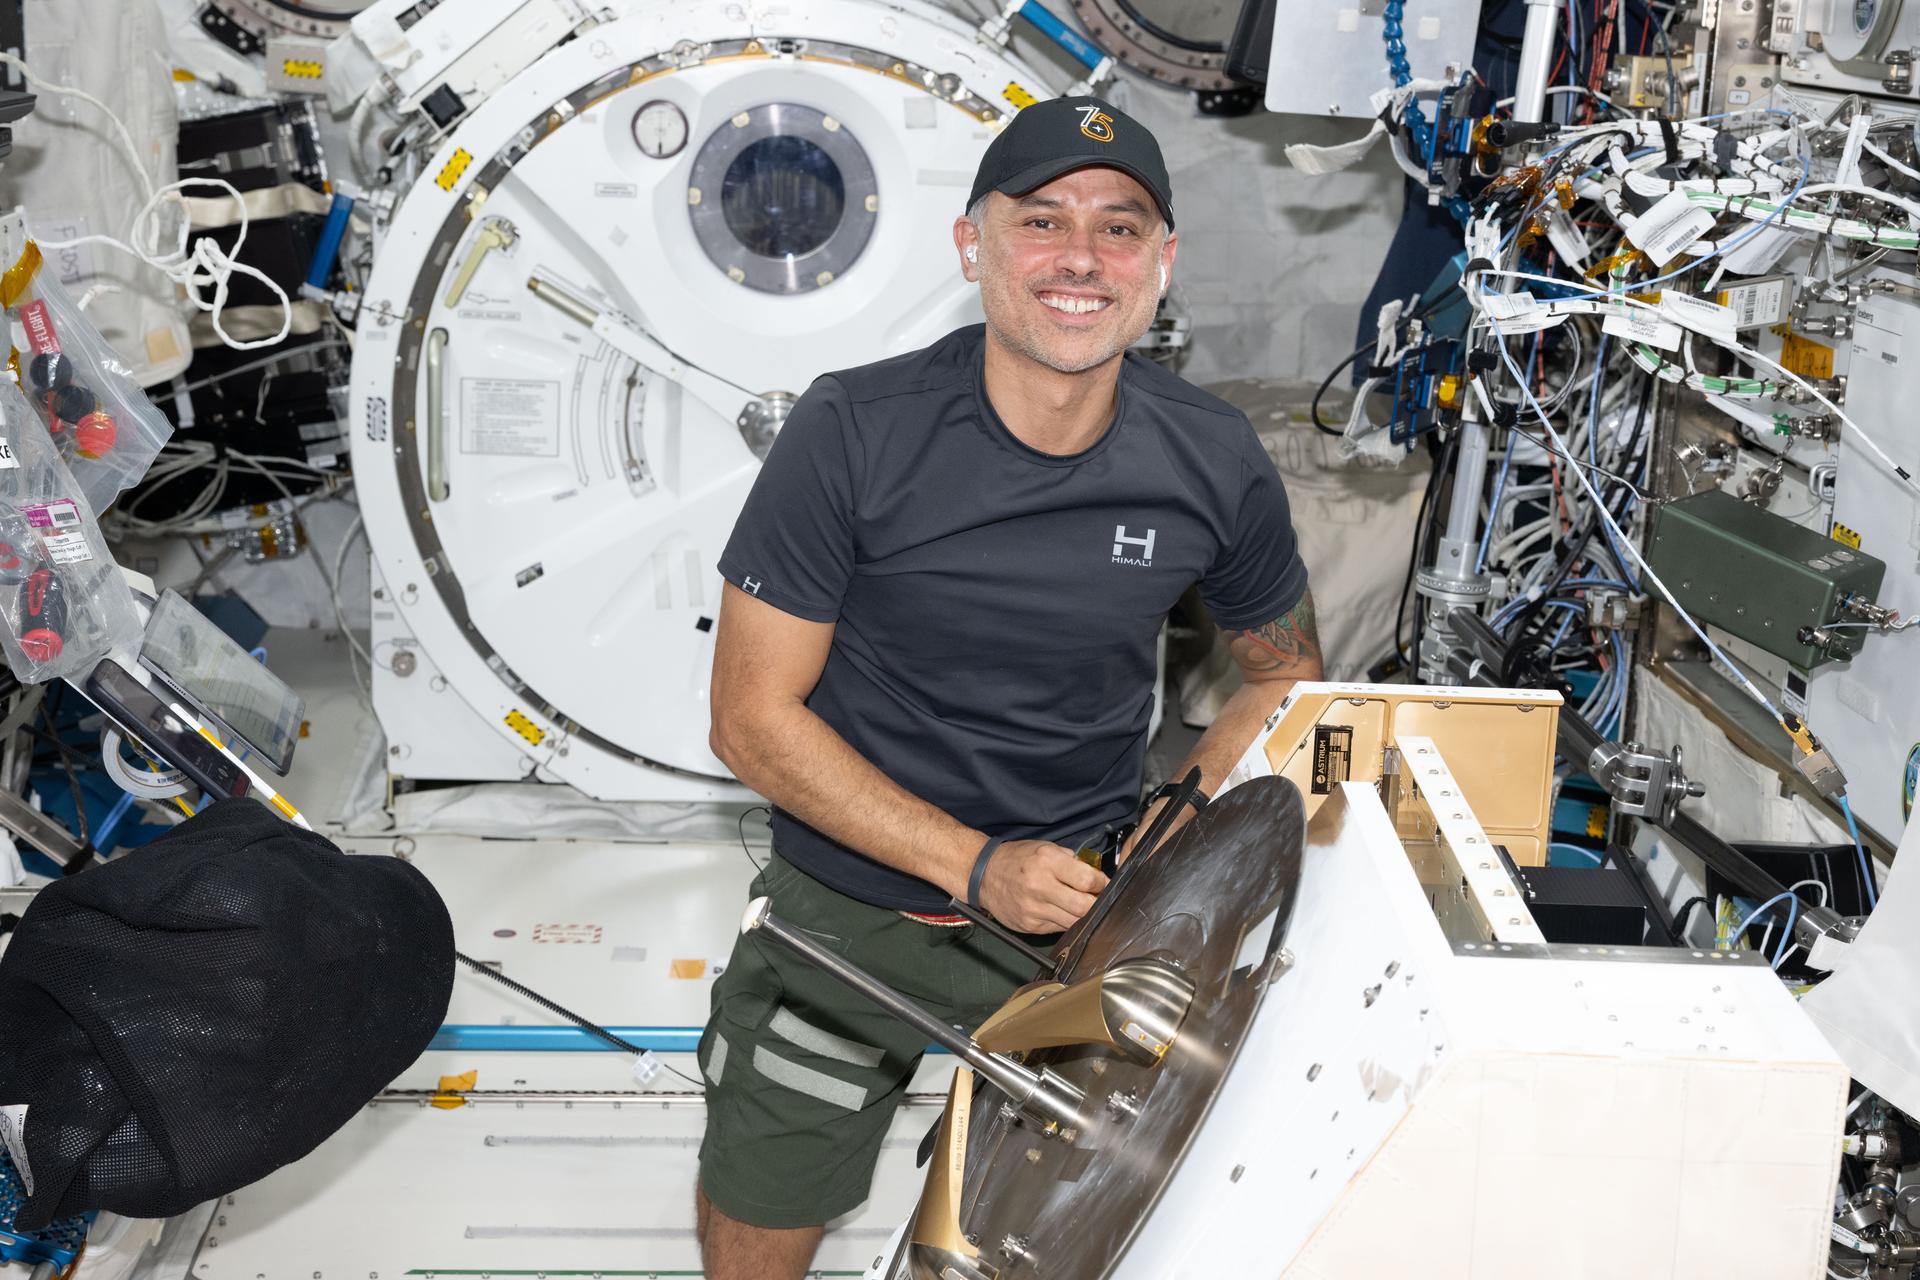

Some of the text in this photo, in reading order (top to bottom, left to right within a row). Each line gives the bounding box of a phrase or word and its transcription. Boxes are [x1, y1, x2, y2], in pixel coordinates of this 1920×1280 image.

[1075, 106, 1113, 142] 75
[1112, 556, 1152, 567] HIMALI
[1318, 739, 1327, 774] ASTRIUM
